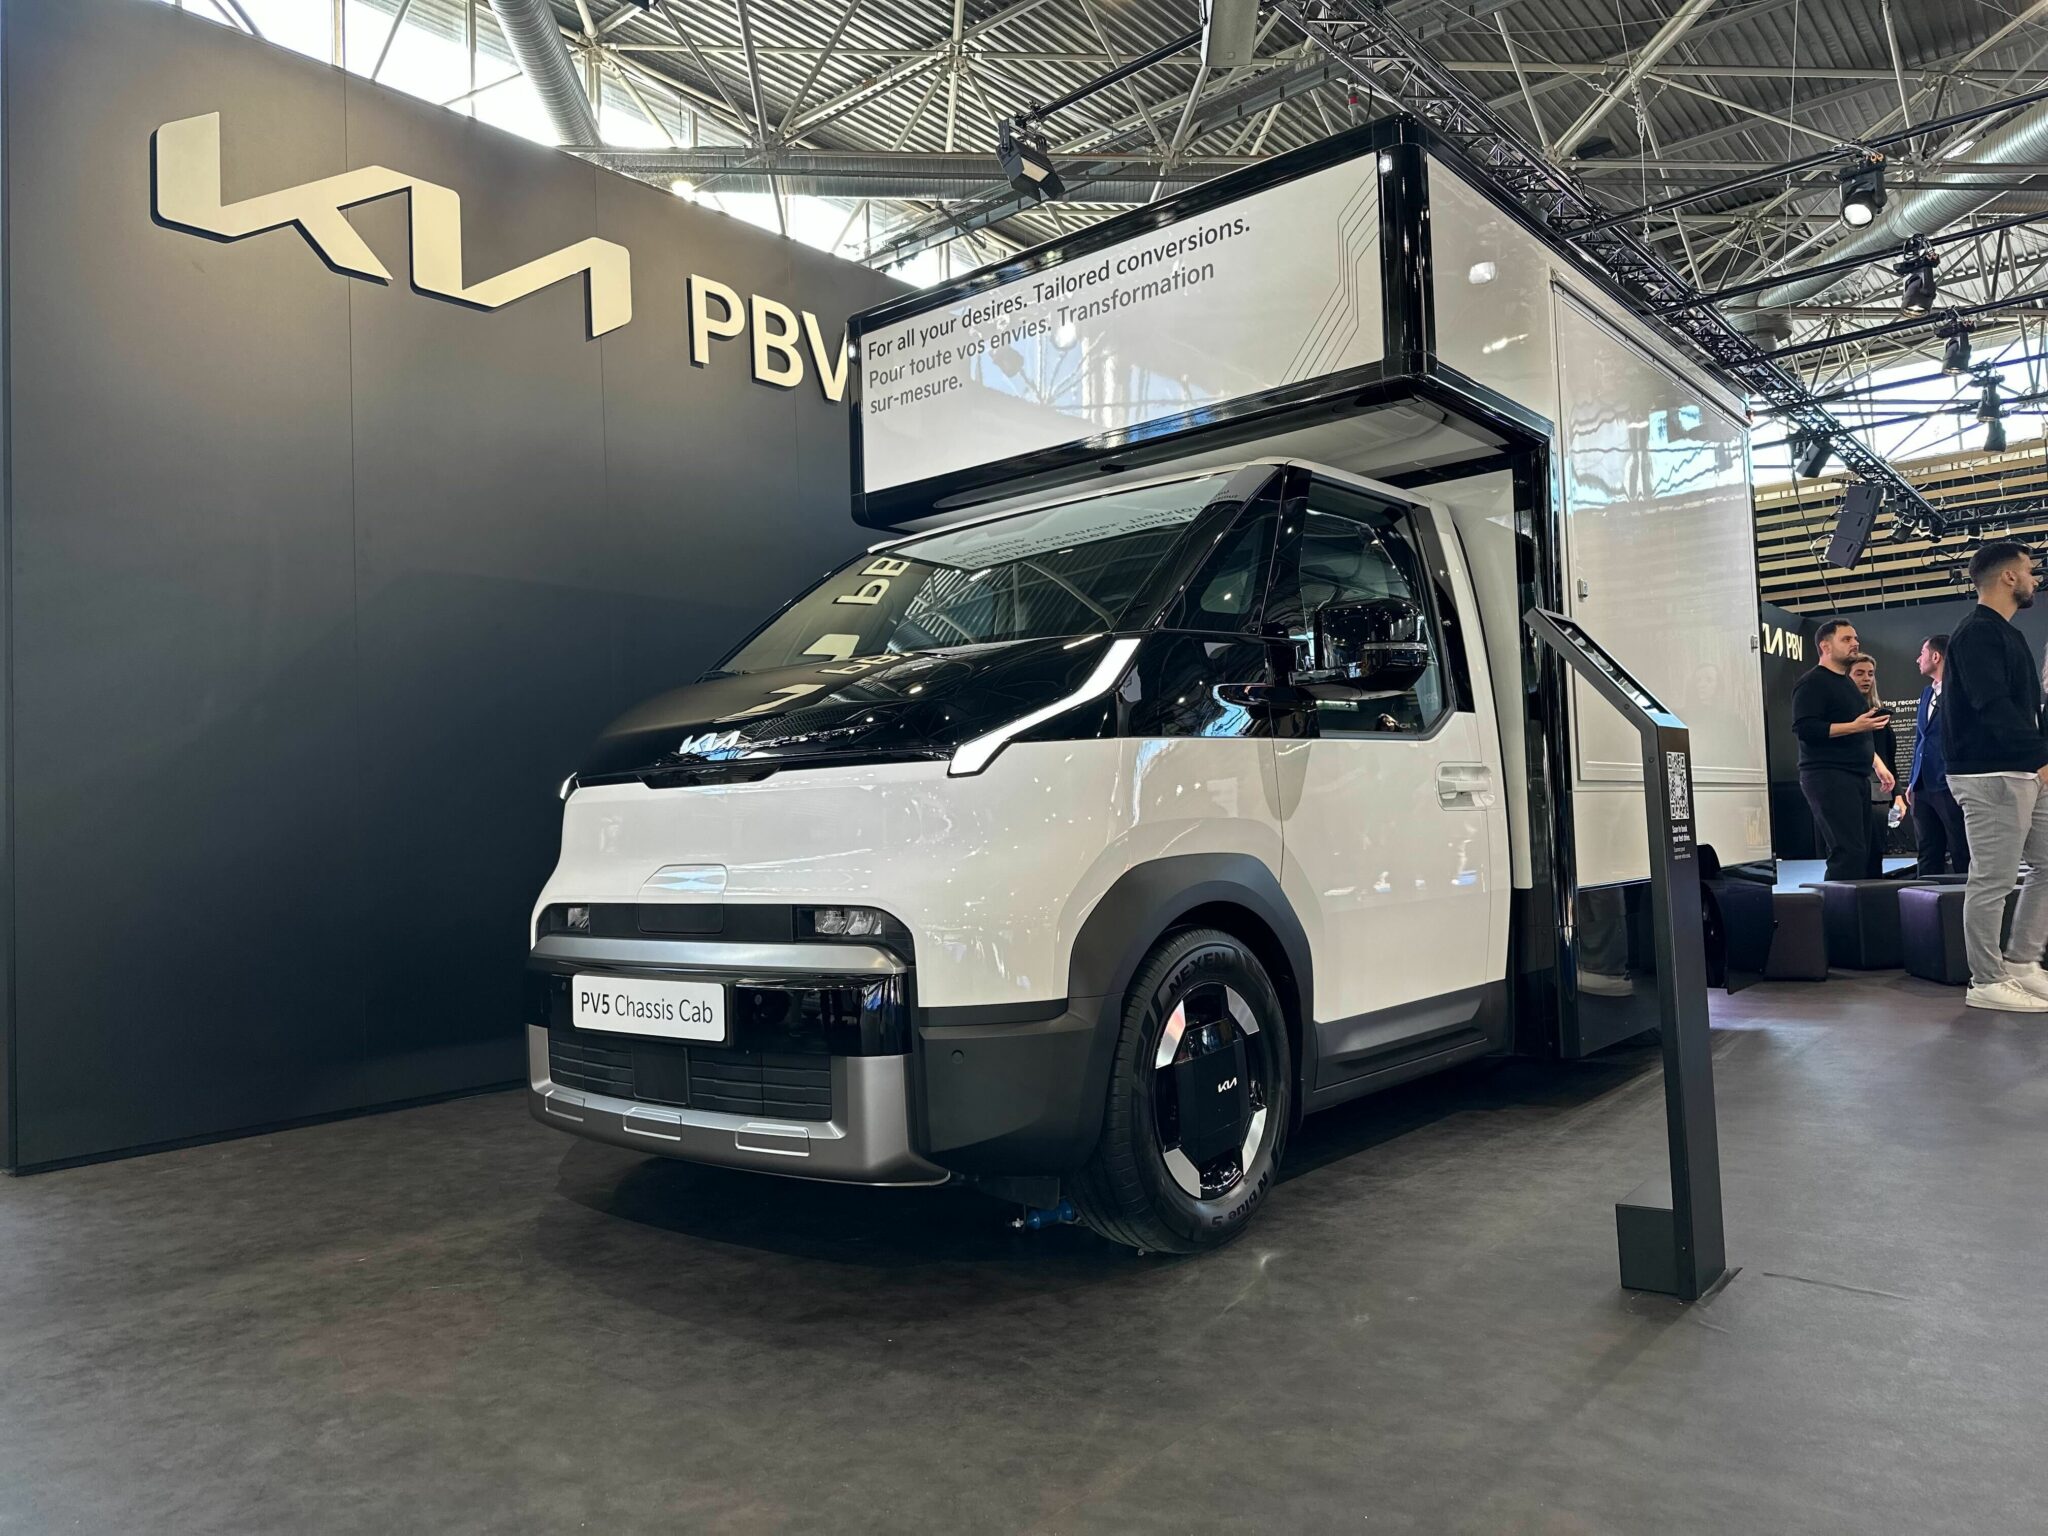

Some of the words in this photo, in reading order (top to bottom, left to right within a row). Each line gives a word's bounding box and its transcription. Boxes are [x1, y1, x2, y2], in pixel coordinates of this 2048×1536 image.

[868, 340, 893, 361] For
[897, 328, 915, 351] all
[919, 320, 958, 347] your
[961, 294, 1028, 329] desires.
[1032, 260, 1111, 304] Tailored
[1116, 216, 1251, 276] conversions.
[691, 274, 848, 403] PBV
[869, 365, 905, 389] Pour
[909, 352, 953, 376] toute
[957, 338, 986, 359] vos
[990, 318, 1052, 351] envies.
[1057, 261, 1215, 327] Transformation
[869, 379, 964, 415] sur-mesure.
[1785, 631, 1803, 662] PBV
[1168, 951, 1226, 995] NEXEN
[580, 991, 611, 1016] PV5
[614, 993, 674, 1022] Chassis
[678, 999, 714, 1024] Cab
